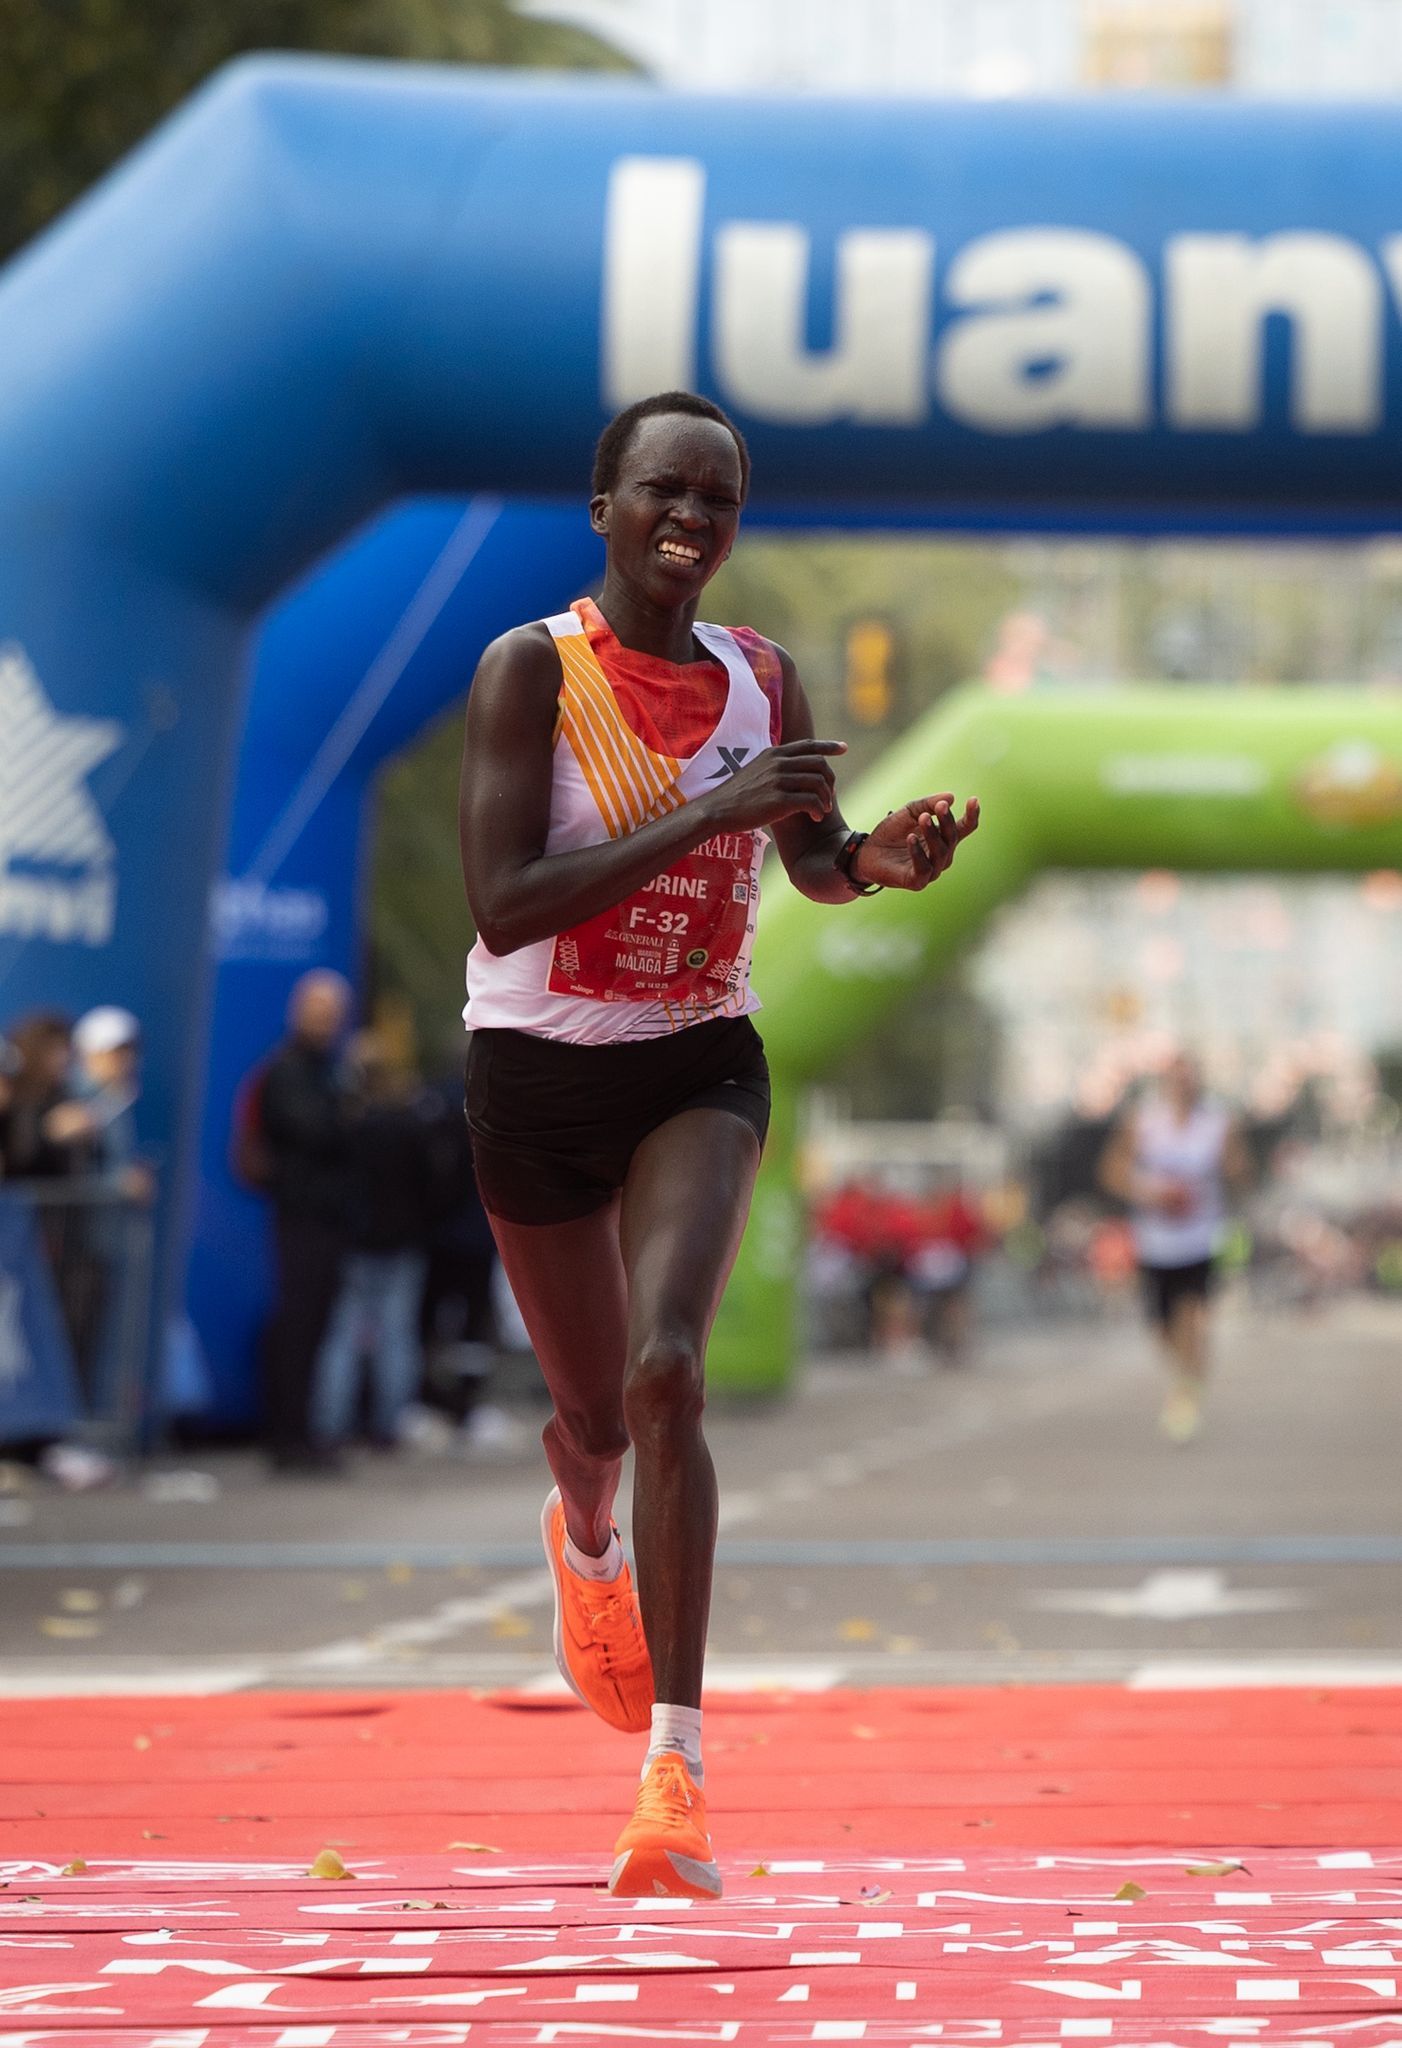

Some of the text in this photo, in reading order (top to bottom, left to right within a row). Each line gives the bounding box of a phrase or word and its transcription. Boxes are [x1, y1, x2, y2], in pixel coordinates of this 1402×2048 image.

[602, 155, 1402, 435] luan
[629, 906, 690, 935] F-32
[618, 931, 664, 948] GENERALI
[615, 952, 662, 975] MÁLAGA
